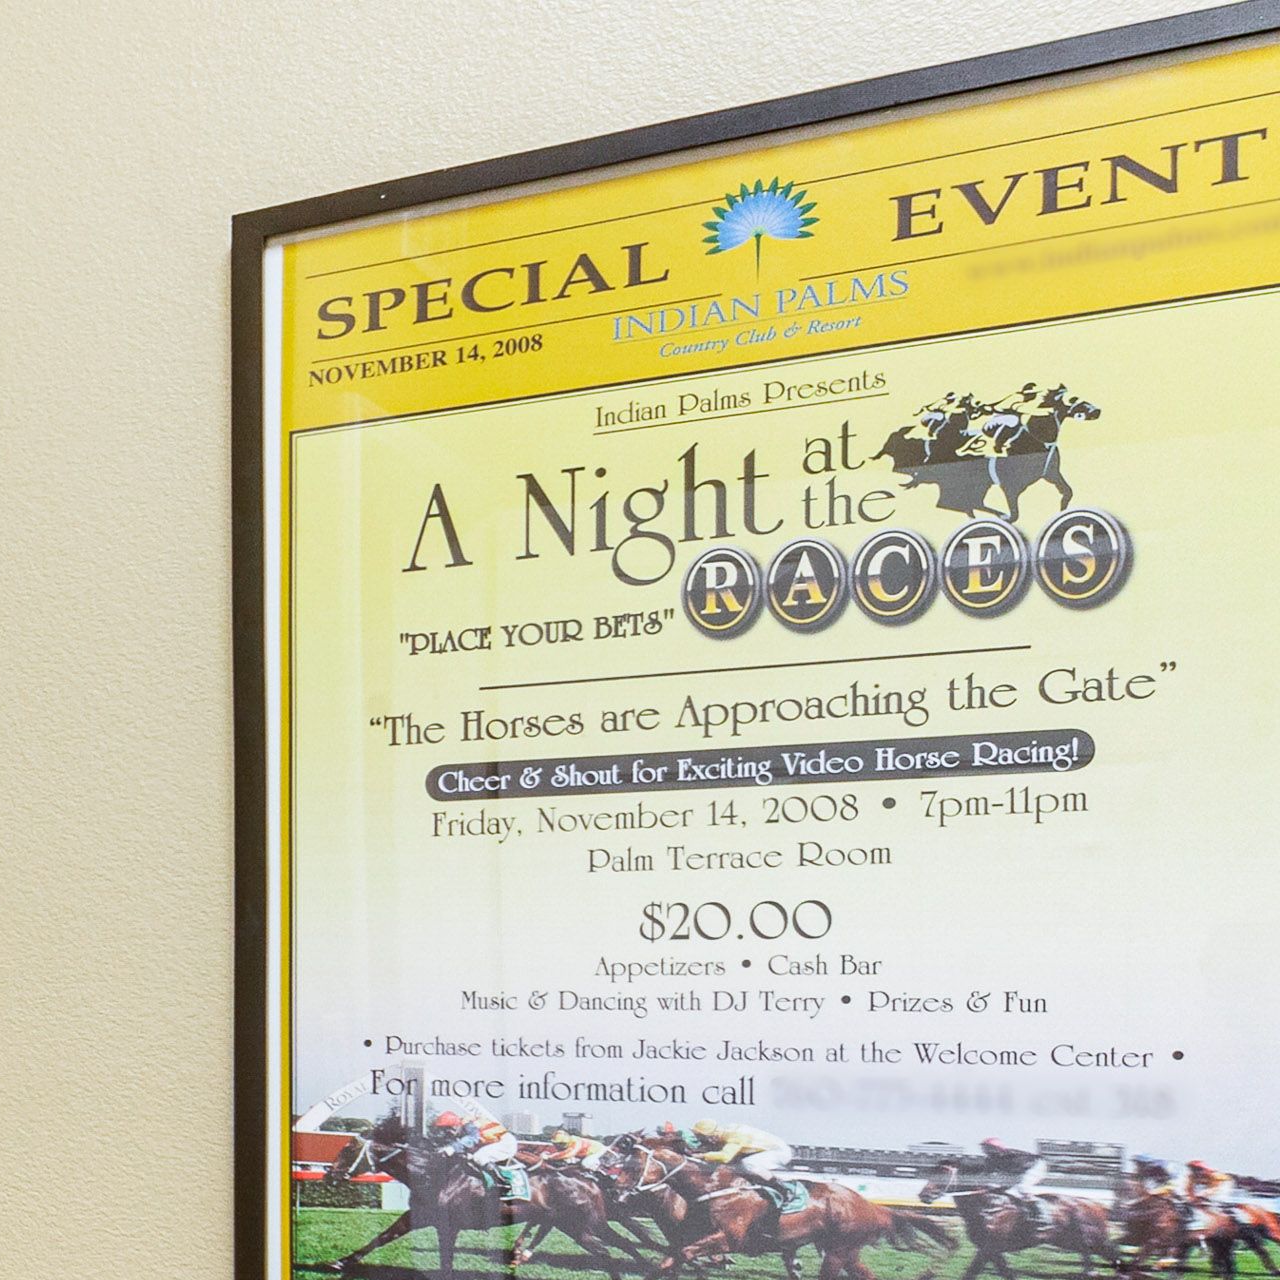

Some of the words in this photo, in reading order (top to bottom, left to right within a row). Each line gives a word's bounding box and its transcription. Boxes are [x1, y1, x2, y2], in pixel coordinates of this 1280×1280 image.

[317, 242, 669, 341] SPECIAL
[888, 127, 1268, 242] EVENT
[612, 293, 761, 341] INDIAN
[777, 269, 910, 316] PALMS
[308, 346, 447, 387] NOVEMBER
[455, 343, 486, 365] 14,
[494, 334, 543, 358] 2008
[659, 337, 729, 359] Country
[735, 327, 777, 346] Club
[783, 322, 802, 338] &
[806, 315, 862, 335] Resort
[595, 399, 666, 428] Indian
[679, 387, 752, 416] Palms
[763, 368, 887, 405] Presents
[401, 483, 473, 573] A
[515, 442, 784, 586] Night
[801, 419, 866, 475] at
[800, 475, 897, 530] the
[695, 518, 1104, 622] RACES
[500, 618, 584, 648] YOUR
[460, 709, 585, 743] Horses
[600, 705, 661, 734] are
[674, 678, 930, 738] Approaching
[947, 672, 1018, 713] the
[437, 770, 512, 794] Cheer
[519, 765, 542, 788] &
[550, 761, 624, 788] Shout
[632, 759, 668, 784] for
[676, 755, 773, 785] Exciting
[781, 749, 865, 776] Video
[874, 746, 961, 773] Horse
[971, 737, 1080, 772] Racing!
[431, 809, 523, 844] Friday,
[536, 801, 695, 833] November
[706, 799, 748, 829] 14,
[763, 793, 860, 824] 2008
[920, 786, 1089, 828] 7pm-11pm
[586, 847, 655, 873] Palm
[666, 844, 784, 872] Terrace
[797, 840, 893, 868] Room
[638, 899, 833, 943] $20.00
[594, 955, 727, 983] Appetizers
[767, 953, 829, 977] Cash
[839, 953, 883, 976] Bar
[460, 989, 519, 1012] Music
[527, 989, 548, 1012] &
[558, 989, 648, 1019] Dancing
[656, 989, 702, 1013] with
[711, 989, 747, 1013] DJ
[759, 989, 826, 1019] Terry
[867, 989, 954, 1013] Prizes
[965, 990, 991, 1013] &
[1002, 990, 1049, 1014] Fun
[384, 1035, 482, 1057] Purchase
[491, 1037, 565, 1059] tickets
[574, 1037, 623, 1059] from
[632, 1039, 707, 1062] Jackie
[716, 1040, 814, 1063] Jackson
[825, 1041, 850, 1064] at
[860, 1041, 903, 1064] the
[913, 1041, 1038, 1066] Welcome
[1050, 1043, 1154, 1068] Center
[369, 1068, 419, 1097] For
[431, 1078, 506, 1099] more
[518, 1071, 687, 1105] information
[701, 1076, 757, 1106] call
